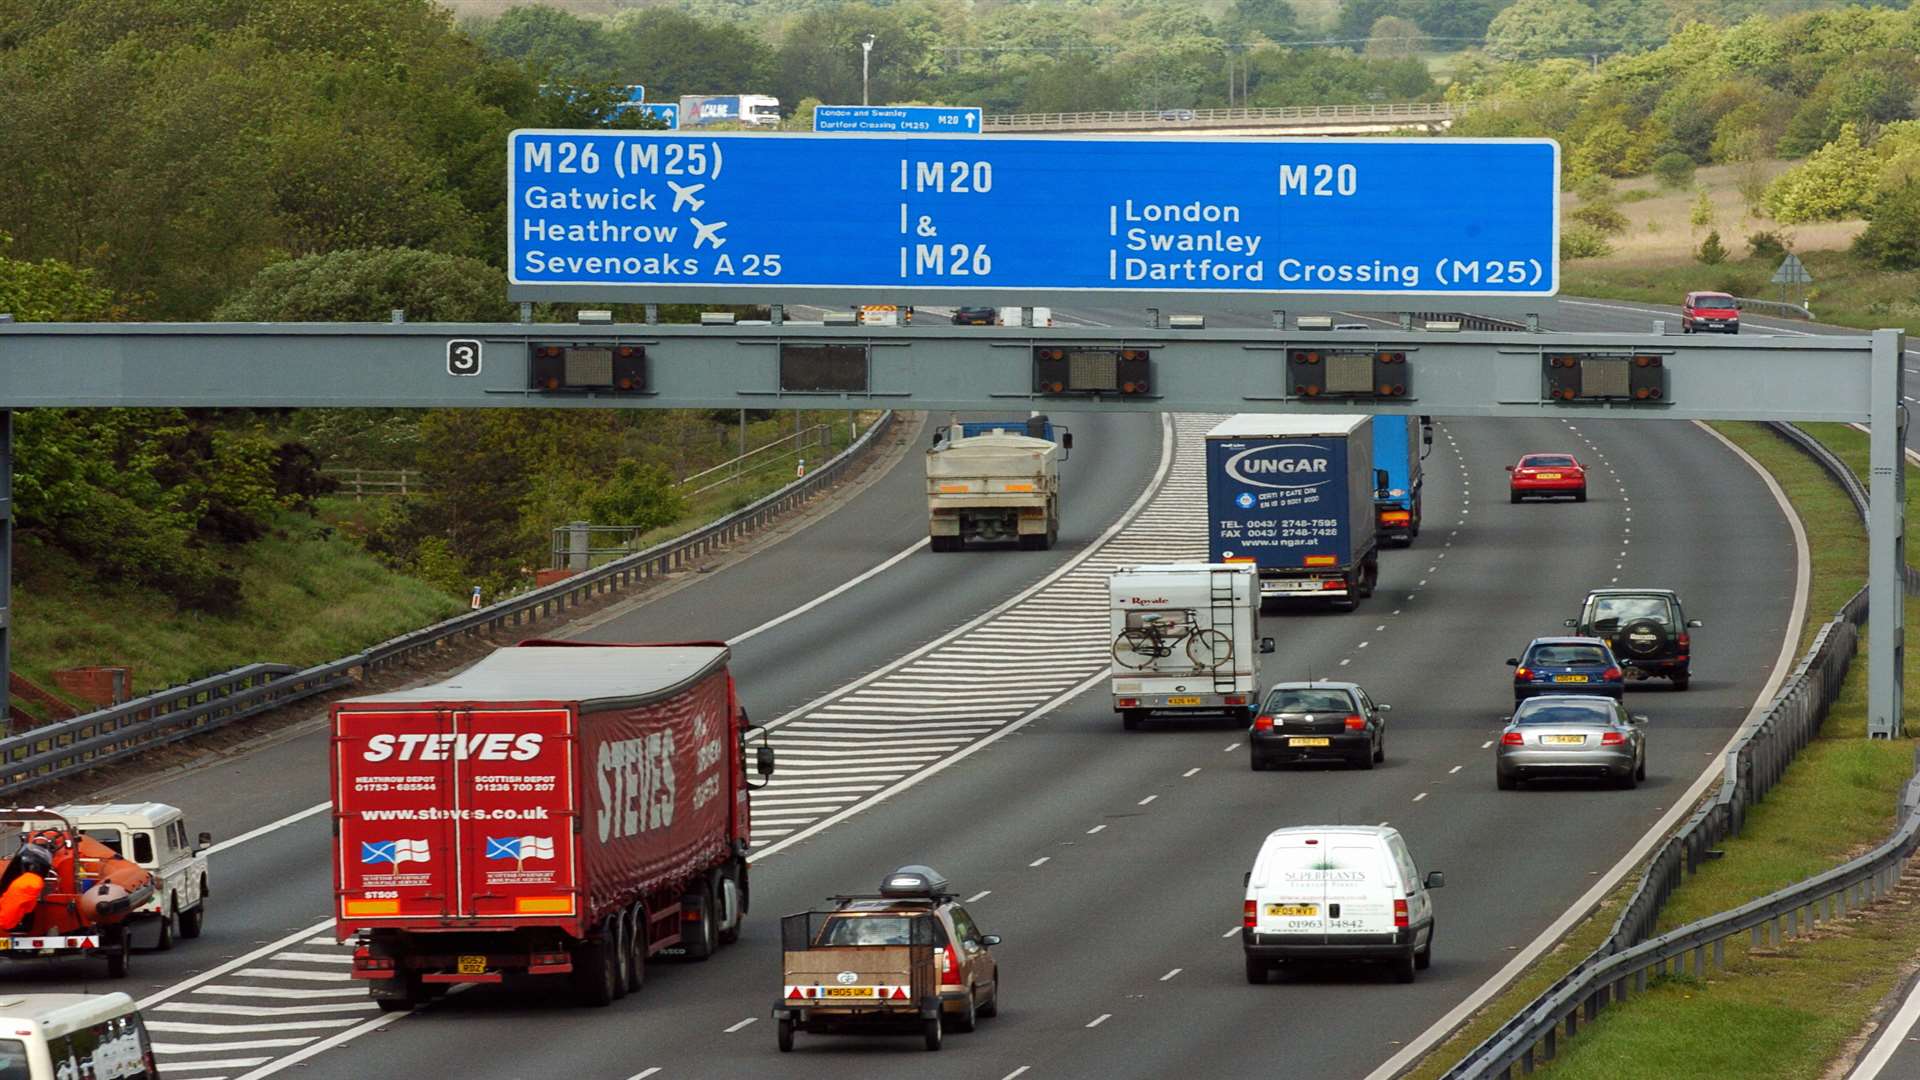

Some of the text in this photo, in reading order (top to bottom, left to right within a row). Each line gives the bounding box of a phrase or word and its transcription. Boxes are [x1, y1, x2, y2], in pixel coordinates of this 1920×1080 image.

[820, 109, 852, 117] London
[871, 109, 907, 118] Swanley
[938, 115, 959, 125] M20
[820, 121, 930, 130] Dartford Crossing (M25)
[525, 141, 723, 179] M26 (M25)
[916, 161, 992, 193] M20
[1280, 164, 1357, 196] M20
[525, 186, 656, 210] Gatwick
[1126, 200, 1240, 223] London
[524, 218, 678, 243] Heathrow
[917, 215, 937, 237] &
[1127, 228, 1262, 256] Swanley
[525, 251, 698, 276] Sevenoaks
[916, 243, 992, 276] M26
[1126, 258, 1543, 287] Dartford Crossing (M25)
[454, 347, 474, 369] 3
[1244, 458, 1329, 474] UNGAR
[1220, 520, 1243, 529] TEL.
[1220, 529, 1241, 538] FAX
[1131, 597, 1169, 607] Royale
[363, 733, 543, 762] STEVES
[354, 784, 389, 792] 01753
[355, 775, 436, 784] HEATHROW DEPOT
[474, 775, 556, 783] SCOTTISH DEPOT
[512, 783, 533, 792] 700
[534, 783, 555, 792] 207
[597, 728, 676, 844] STEVES
[361, 806, 549, 821] www.steves.co.uk
[1284, 871, 1366, 880] SUPERPLANTS
[1288, 918, 1364, 929] 01963 34842
